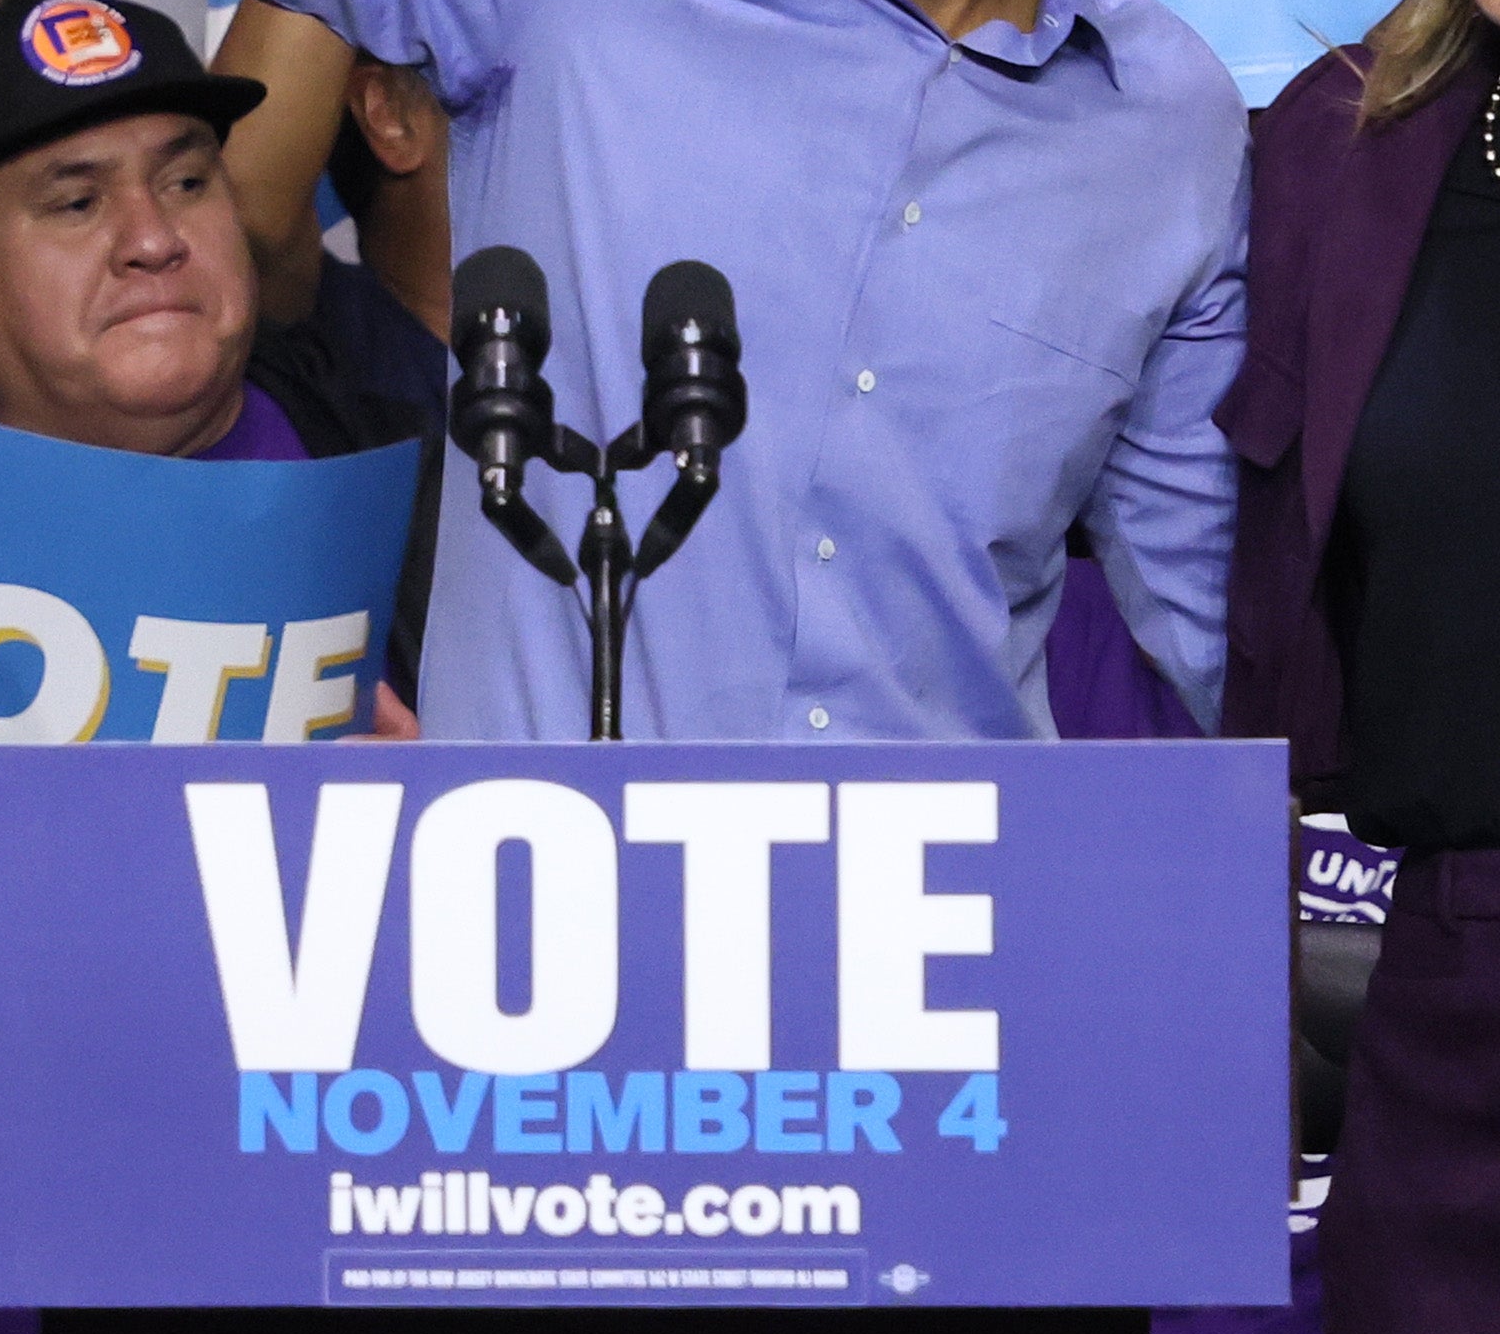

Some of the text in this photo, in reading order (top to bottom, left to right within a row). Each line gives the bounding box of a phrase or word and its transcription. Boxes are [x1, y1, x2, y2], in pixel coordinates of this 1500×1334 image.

[183, 777, 1000, 1076] VOTE
[238, 1070, 1009, 1156] NOVEMBER 4
[329, 1171, 861, 1238] iwillvote.com
